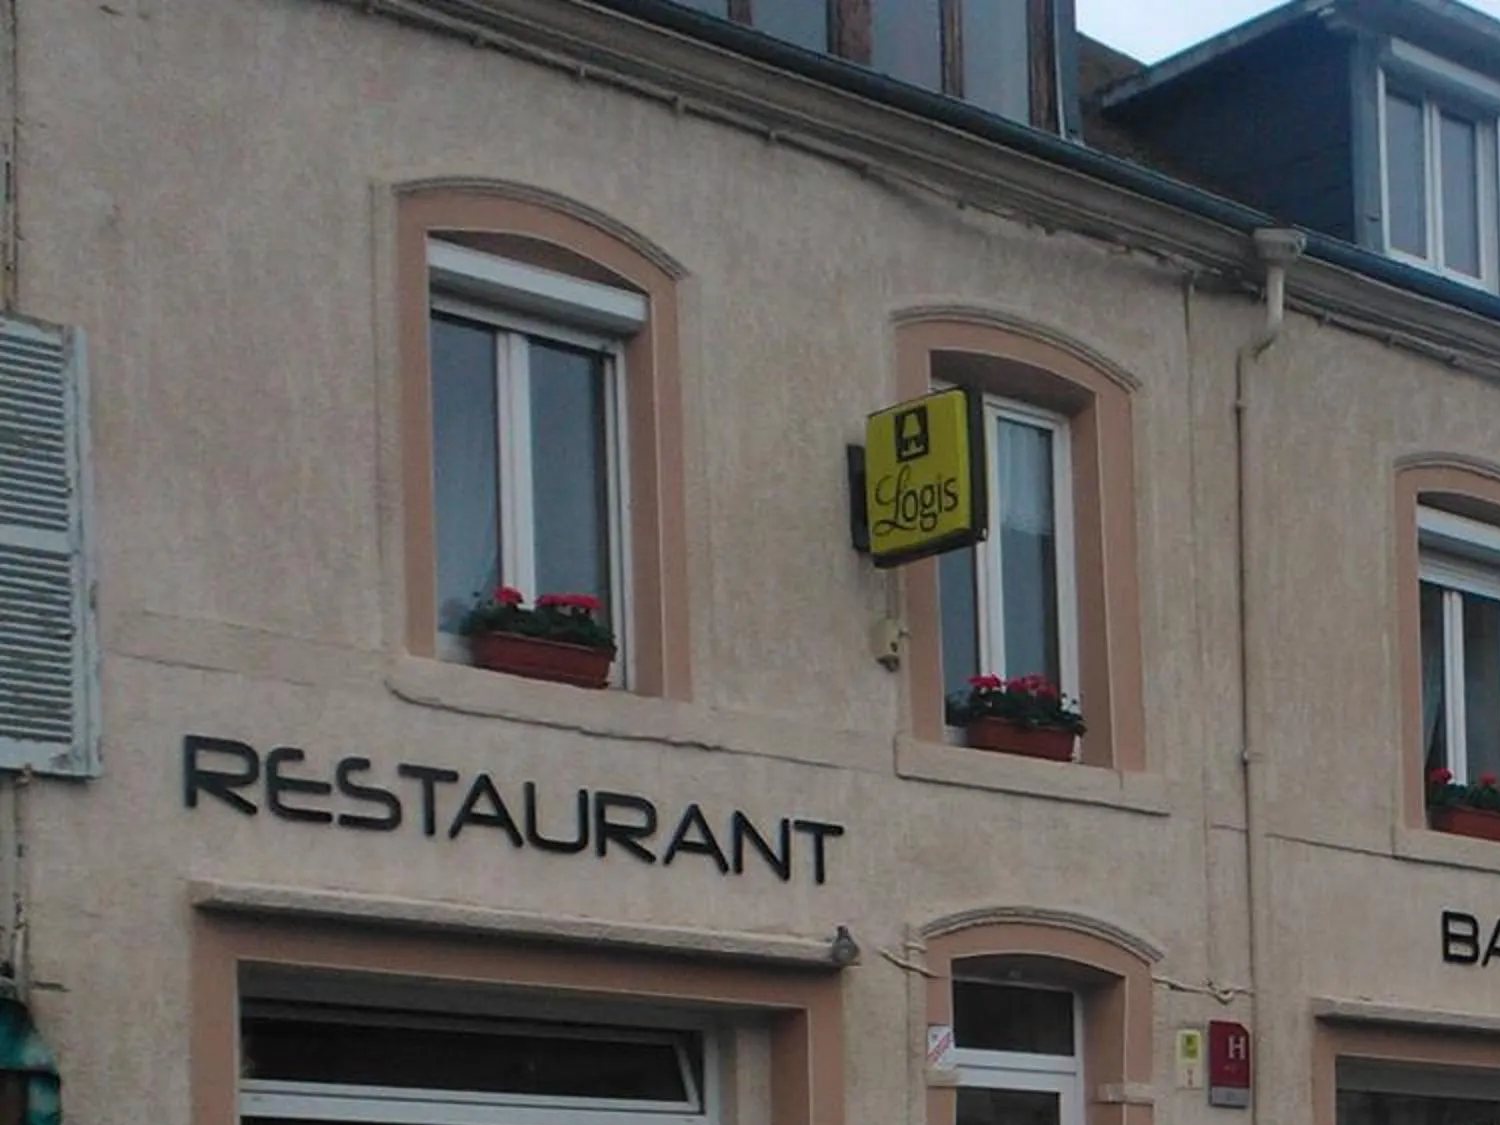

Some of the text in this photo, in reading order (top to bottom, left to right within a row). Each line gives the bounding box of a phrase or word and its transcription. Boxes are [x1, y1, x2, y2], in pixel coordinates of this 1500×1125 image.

[873, 464, 959, 537] Logis
[183, 735, 844, 885] RESTAURANT
[1228, 1035, 1246, 1060] H
